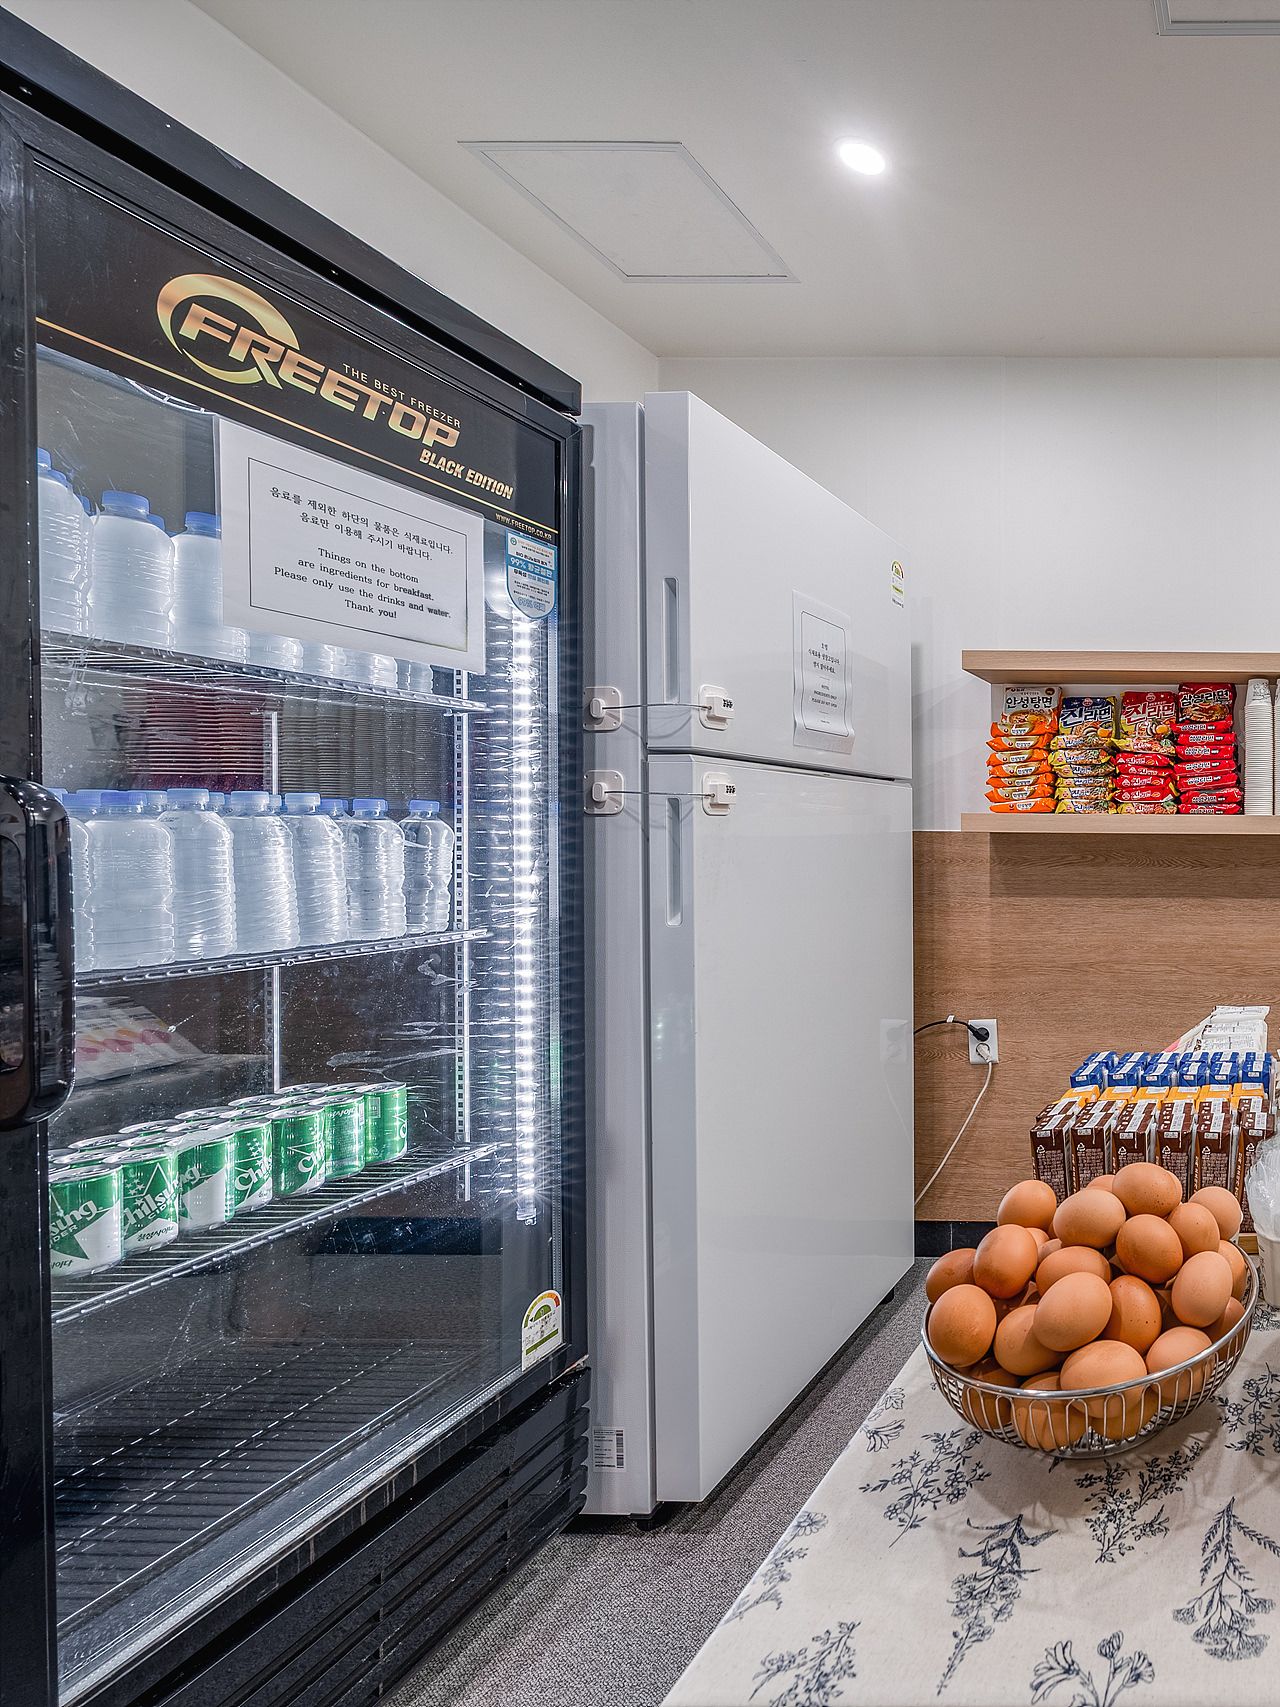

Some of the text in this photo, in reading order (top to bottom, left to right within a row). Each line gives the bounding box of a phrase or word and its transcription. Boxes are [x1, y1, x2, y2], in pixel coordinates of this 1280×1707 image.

[179, 303, 460, 448] FREETOP
[343, 363, 461, 428] THE BEST FREEZER
[419, 448, 514, 500] BLACK EDITION
[269, 487, 453, 554] 음료를 제외한 하단의 물품은 식재료입니다.
[300, 511, 433, 561] 음료만 이용해 주시기 바랍니다.
[495, 513, 552, 541] WWW.FREETOP.CO.KR
[298, 559, 435, 601] are ingredients for breakfast.
[317, 548, 419, 584] Things on the bottom
[274, 567, 451, 619] Please only use the drinks and water.
[344, 599, 397, 619] Thank you!
[1006, 696, 1053, 709] 안성탕면
[1060, 705, 1112, 727] 진라면
[1122, 702, 1175, 724] 진라면
